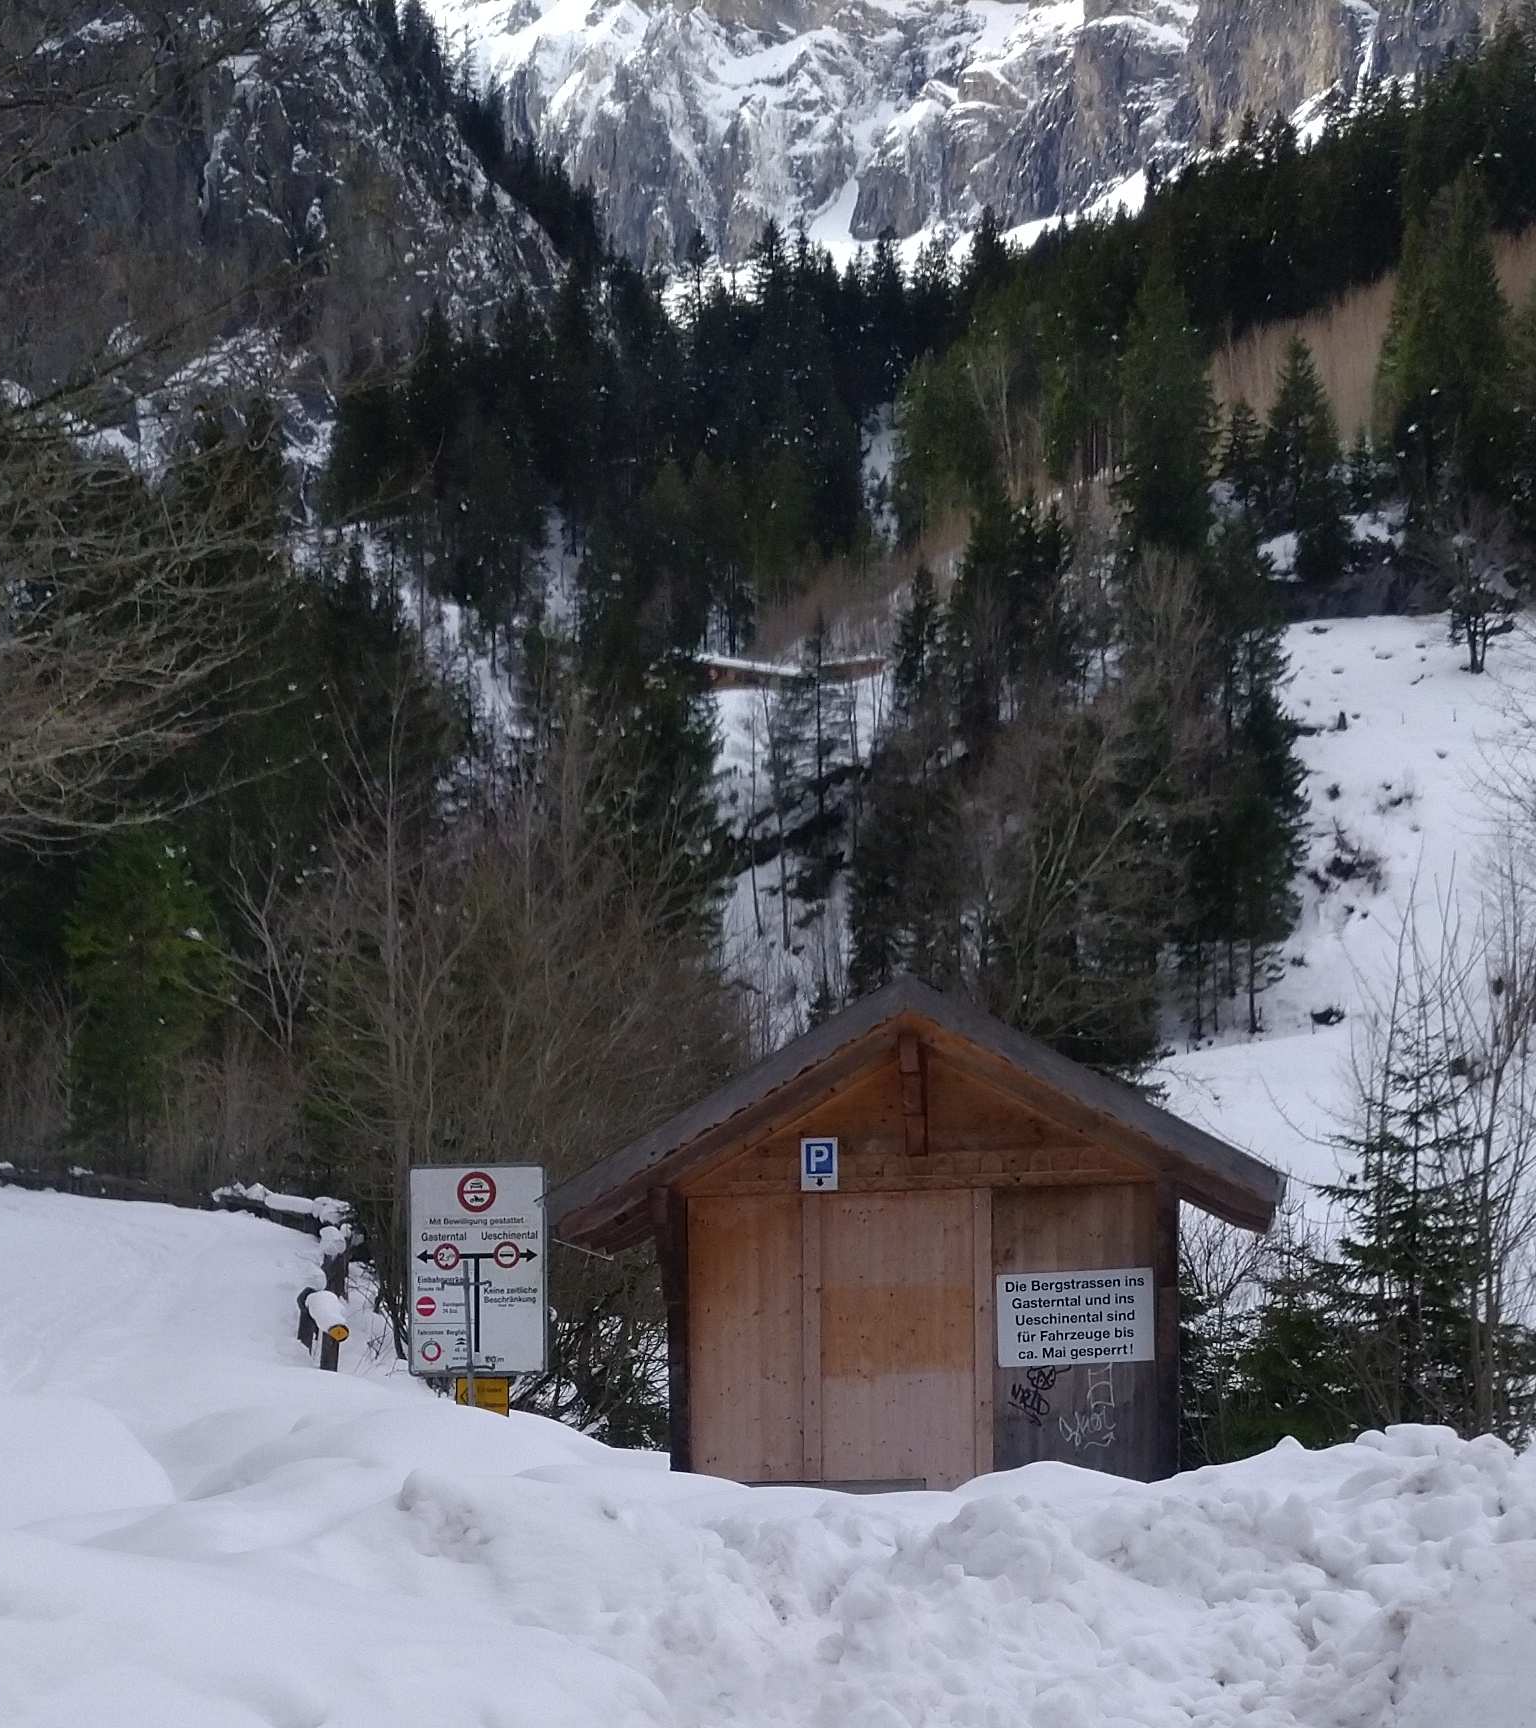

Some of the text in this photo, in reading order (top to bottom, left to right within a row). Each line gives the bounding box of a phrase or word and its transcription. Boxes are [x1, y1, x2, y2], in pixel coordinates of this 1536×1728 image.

[810, 1145, 829, 1172] P
[429, 1217, 441, 1225] Mit
[489, 1216, 524, 1225] gestattet
[421, 1230, 538, 1241] Gasterntal Ueschinental
[484, 1286, 538, 1295] Keine zeitliche
[1005, 1275, 1145, 1293] Die Bergstrassen ins
[484, 1295, 537, 1304] Beschränkung
[1011, 1293, 1135, 1309] Gasterntal und ins
[1015, 1309, 1135, 1326] Ueschinental sind
[1017, 1327, 1134, 1343] für Fahrzeuge bis
[1018, 1343, 1134, 1360] ca. Mai gesperrt!
